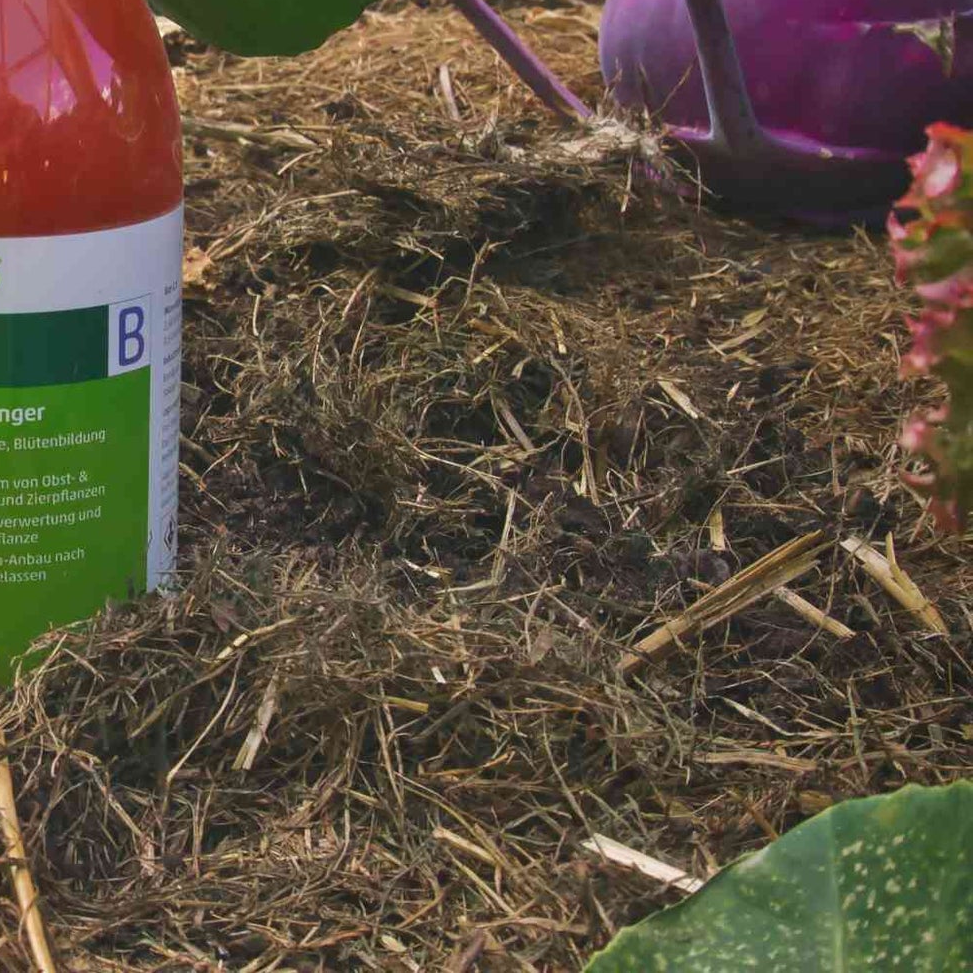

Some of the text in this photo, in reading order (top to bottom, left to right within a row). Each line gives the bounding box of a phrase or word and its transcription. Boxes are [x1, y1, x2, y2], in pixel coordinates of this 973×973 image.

[118, 305, 145, 367] B
[14, 429, 106, 450] Blütenbildung
[14, 477, 38, 489] von
[42, 474, 75, 487] Obst-
[79, 471, 88, 482] &
[27, 484, 105, 505] Zierpflanzen
[79, 505, 102, 520] und
[55, 547, 85, 562] nach
